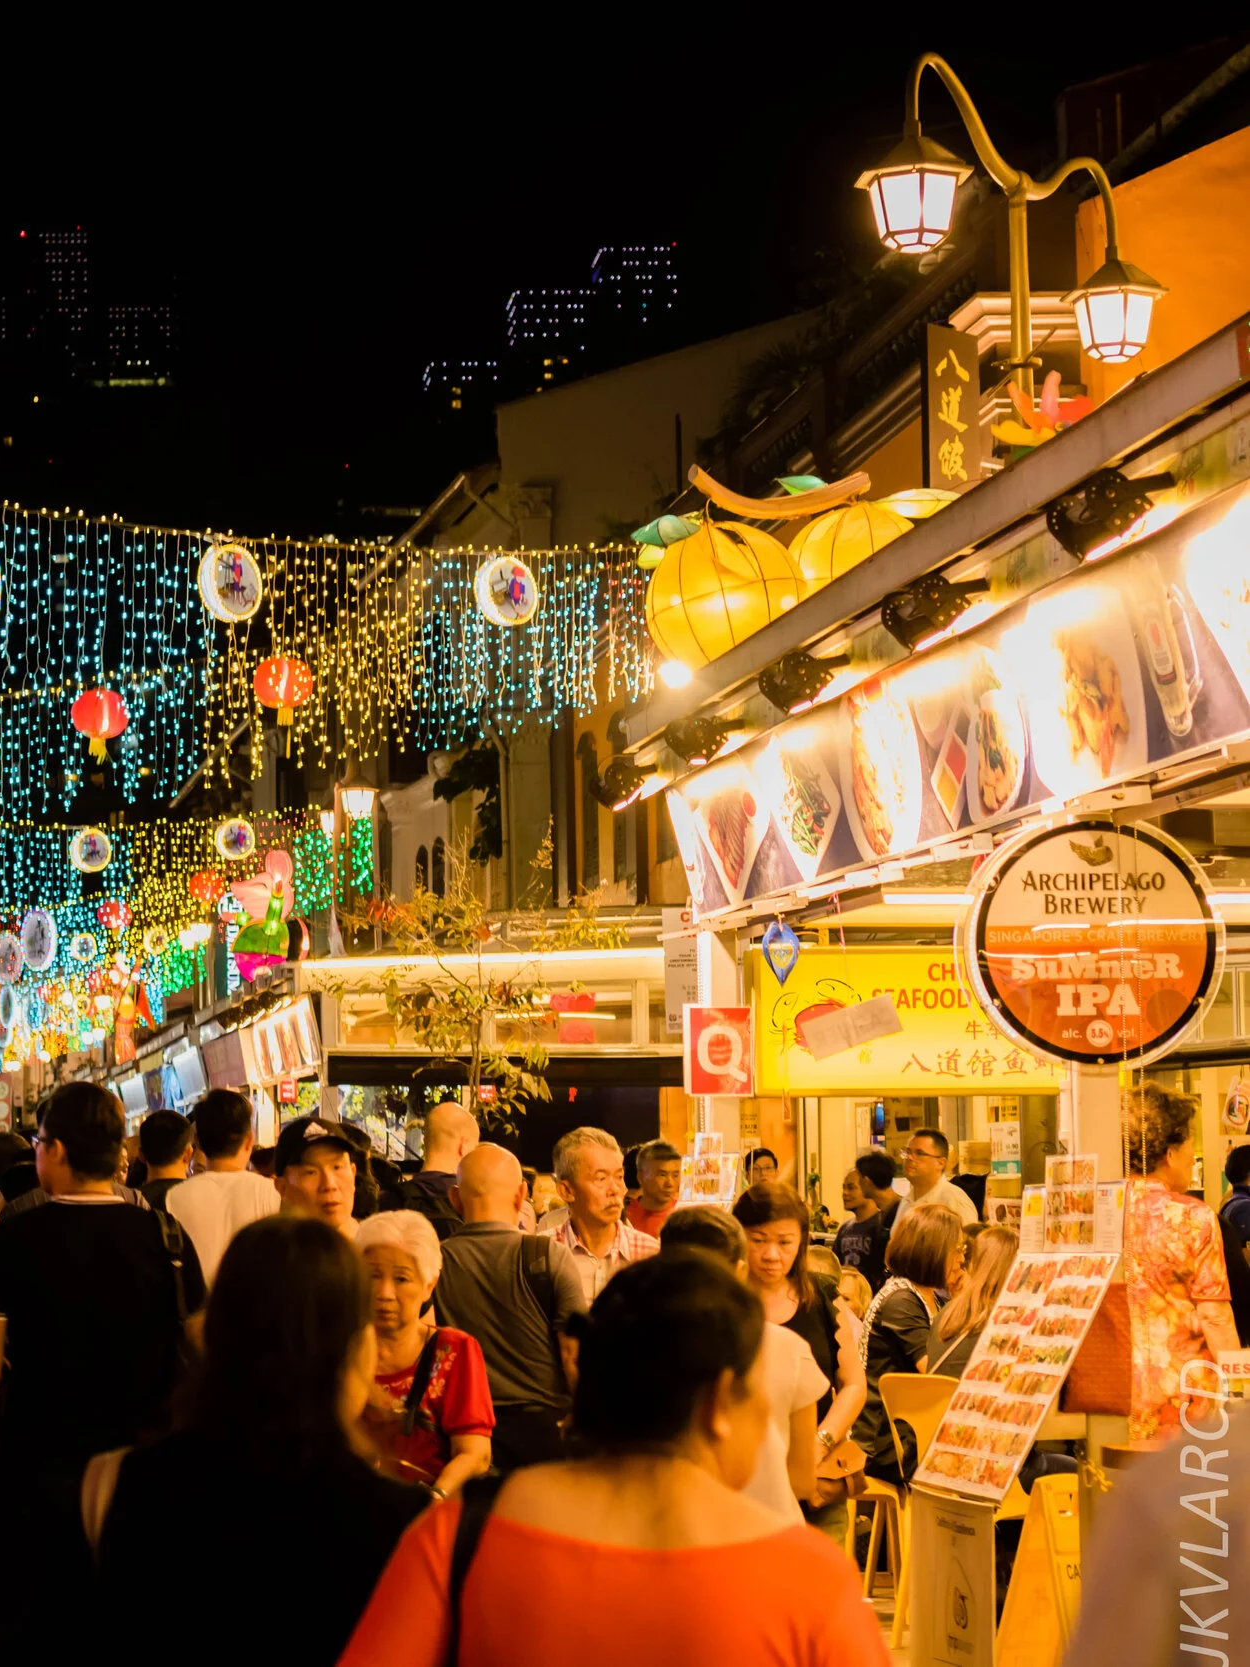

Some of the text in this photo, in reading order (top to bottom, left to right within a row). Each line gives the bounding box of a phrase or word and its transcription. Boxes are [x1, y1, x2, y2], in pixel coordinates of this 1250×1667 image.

[1021, 870, 1165, 891] ARCHIPELAGO
[1044, 894, 1146, 914] BREWERY
[989, 929, 1205, 943] SINGAPORE'S CRAFT BREWERY
[872, 988, 972, 1009] AFOOD
[1056, 984, 1141, 1016] IPA
[1062, 1028, 1083, 1038] alc.
[1116, 1027, 1138, 1038] vol.
[697, 1025, 748, 1083] Q
